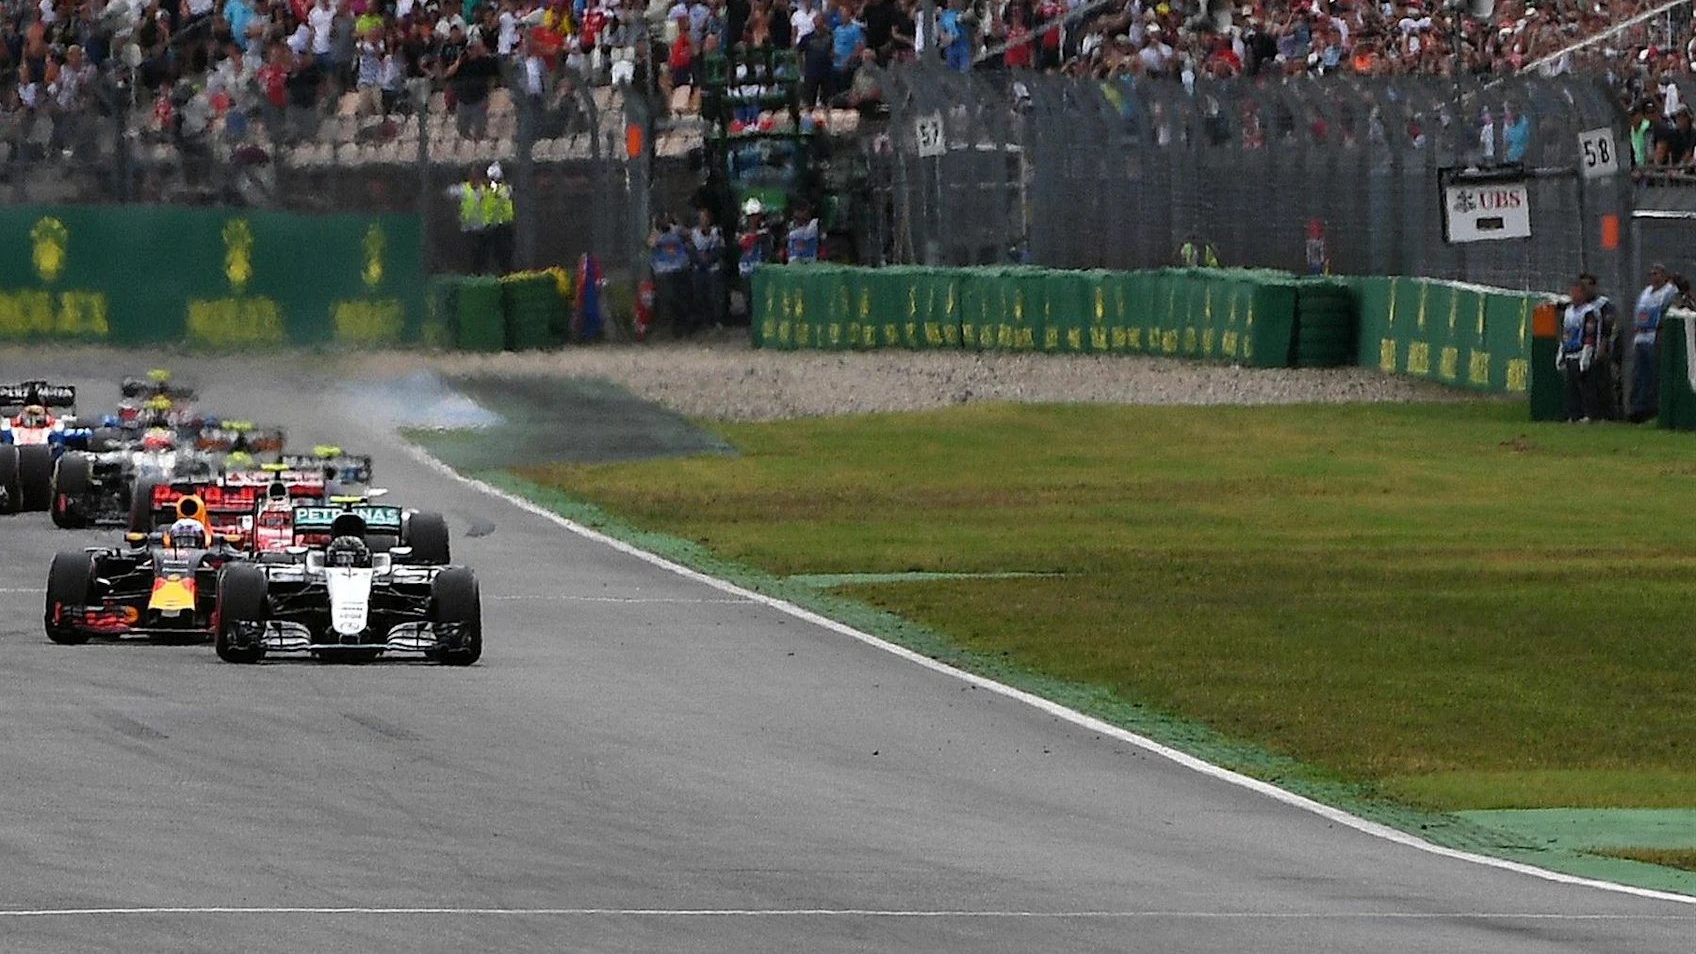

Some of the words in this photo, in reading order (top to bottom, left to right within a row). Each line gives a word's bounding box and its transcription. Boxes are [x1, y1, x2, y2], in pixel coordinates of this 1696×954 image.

[1583, 137, 1611, 168] 58
[1479, 188, 1521, 211] UBS
[296, 507, 400, 521] PETRNAS
